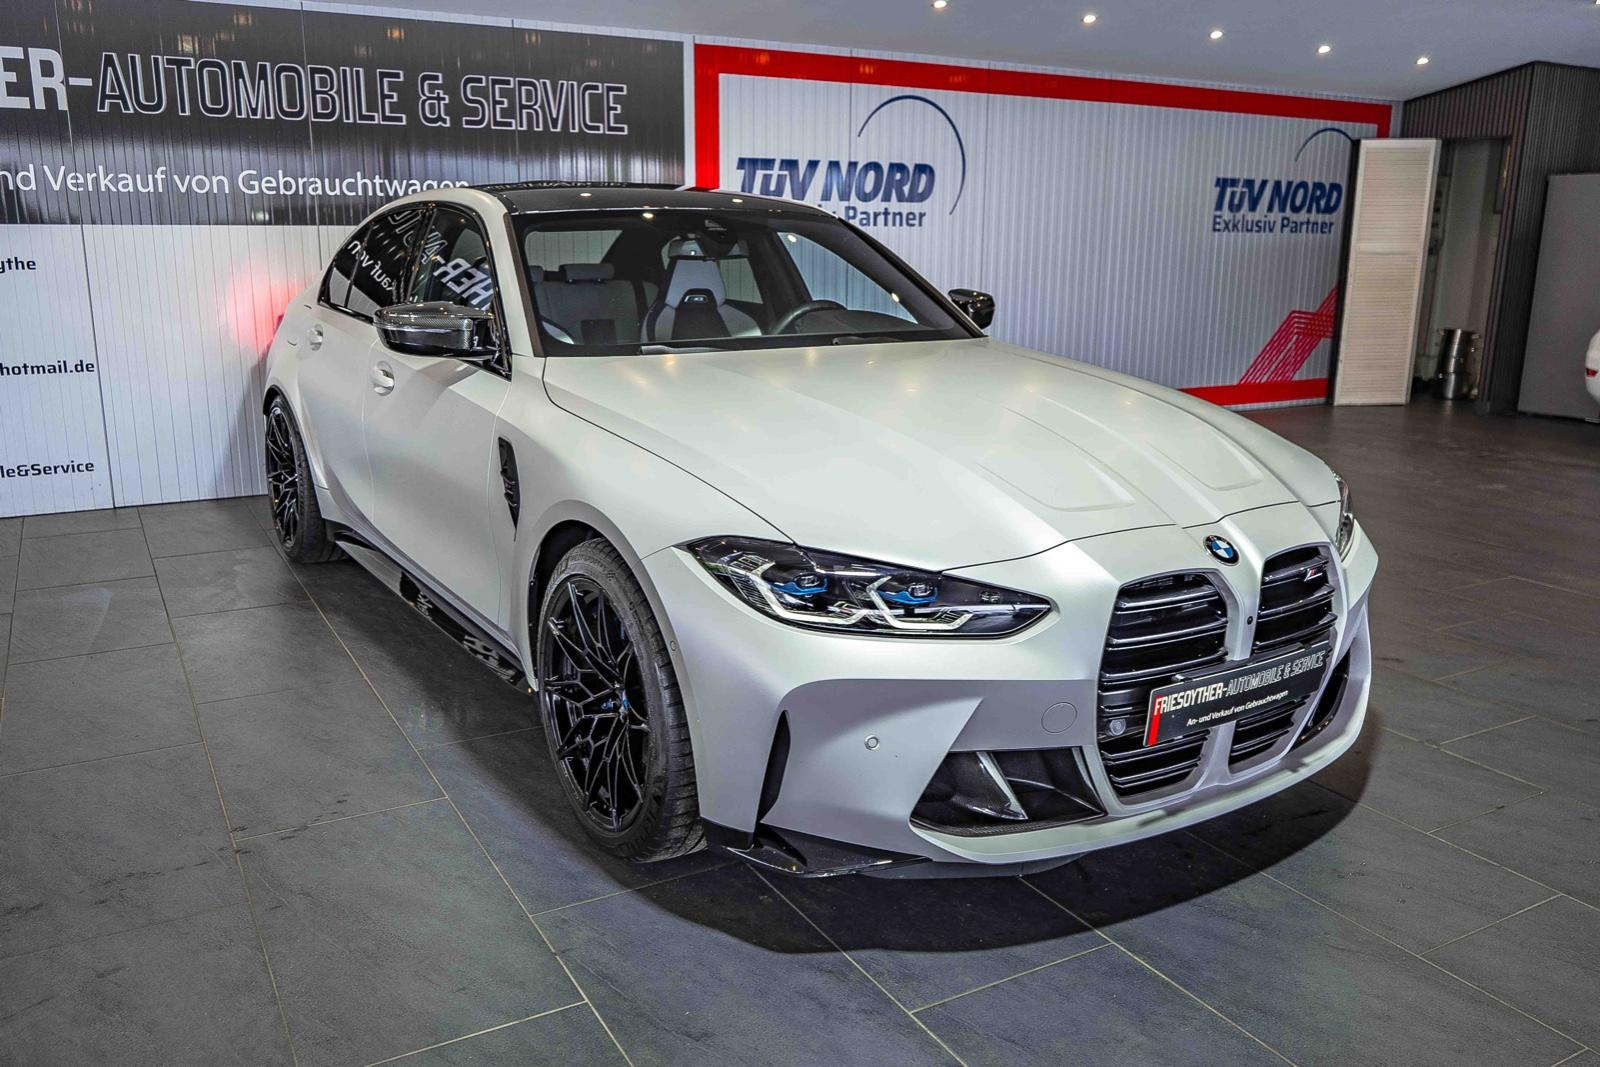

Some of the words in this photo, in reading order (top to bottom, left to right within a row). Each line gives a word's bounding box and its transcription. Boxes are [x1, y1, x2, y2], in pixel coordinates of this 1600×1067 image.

[418, 72, 450, 127] &
[460, 75, 628, 135] SERVICE
[43, 165, 166, 193] Verkauf
[173, 174, 230, 194] von
[736, 157, 821, 202] TÜV
[821, 160, 936, 204] NORD
[1214, 176, 1269, 213] TÜV
[1266, 180, 1343, 215] NORD
[844, 205, 927, 228] Partner
[1212, 215, 1276, 233] Exklusiv
[1280, 217, 1335, 235] Partner
[0, 360, 95, 376] hotmail.de
[0, 461, 95, 479] le&Service
[1290, 651, 1326, 677] SERVICE
[1211, 706, 1235, 720] Verkauf
[1233, 704, 1246, 712] von
[1245, 690, 1289, 710] Gebrauchtwagen
